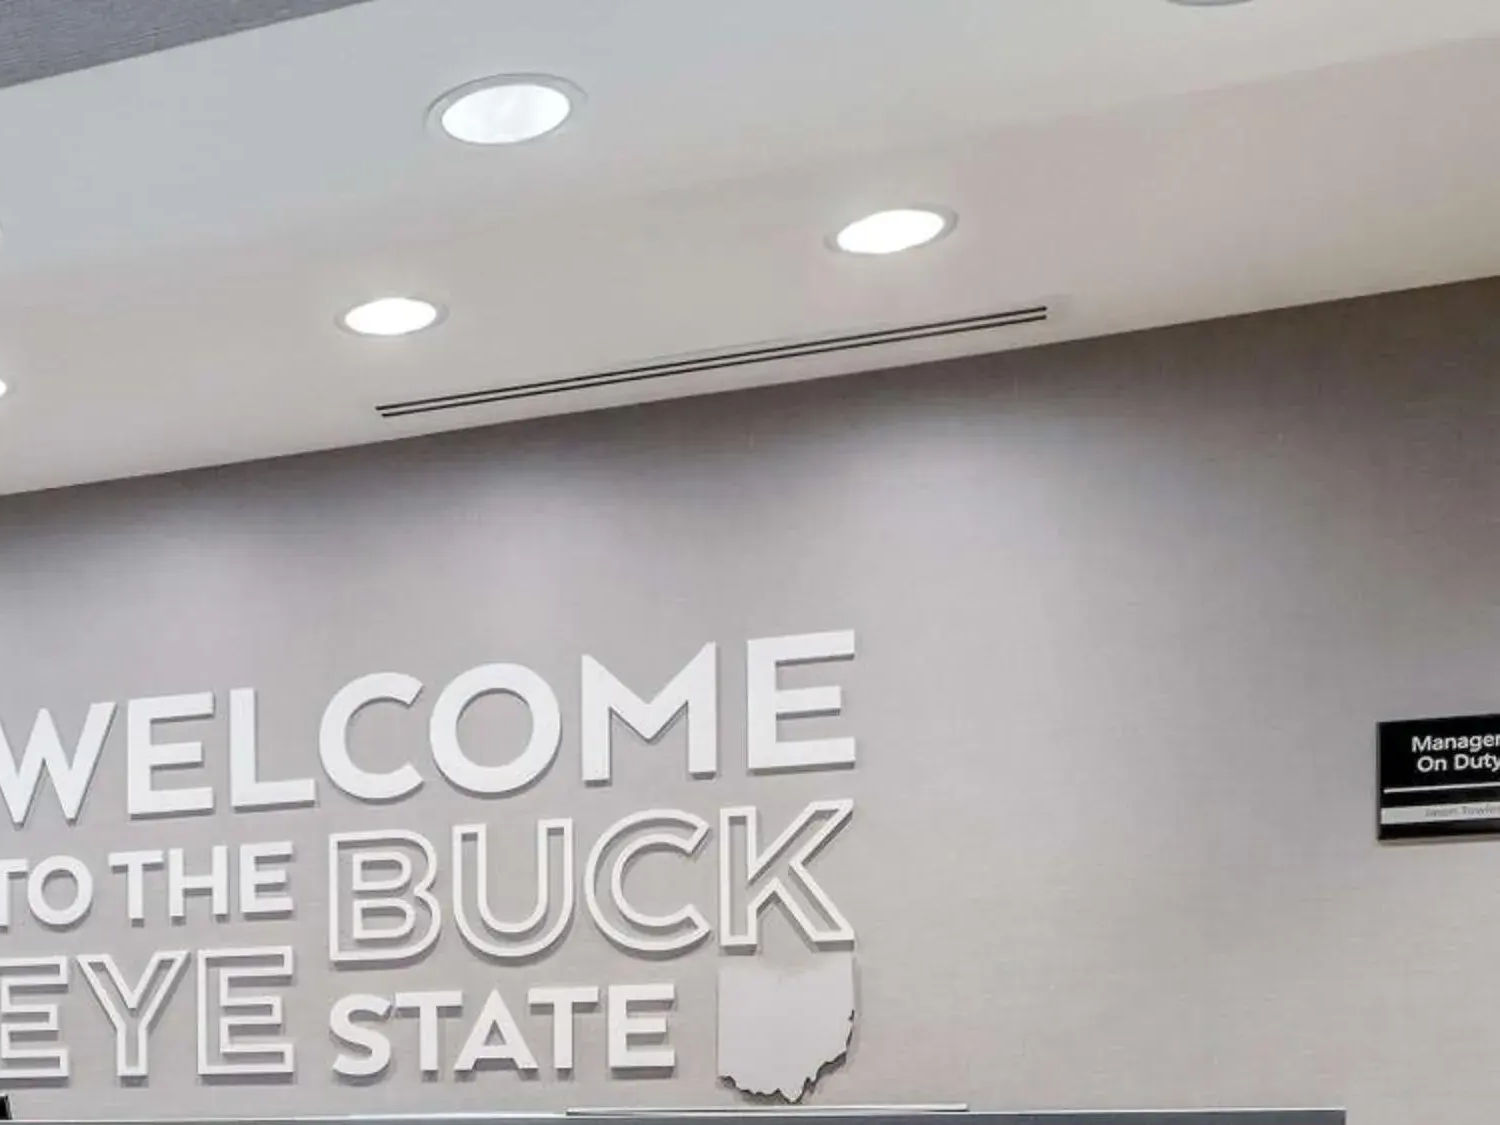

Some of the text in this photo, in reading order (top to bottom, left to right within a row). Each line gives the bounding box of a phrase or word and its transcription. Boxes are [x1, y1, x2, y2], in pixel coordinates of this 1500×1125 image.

[1417, 752, 1500, 773] On Duty
[108, 841, 295, 926] THE
[328, 799, 855, 965] BUCK
[328, 983, 677, 1079] STATE
